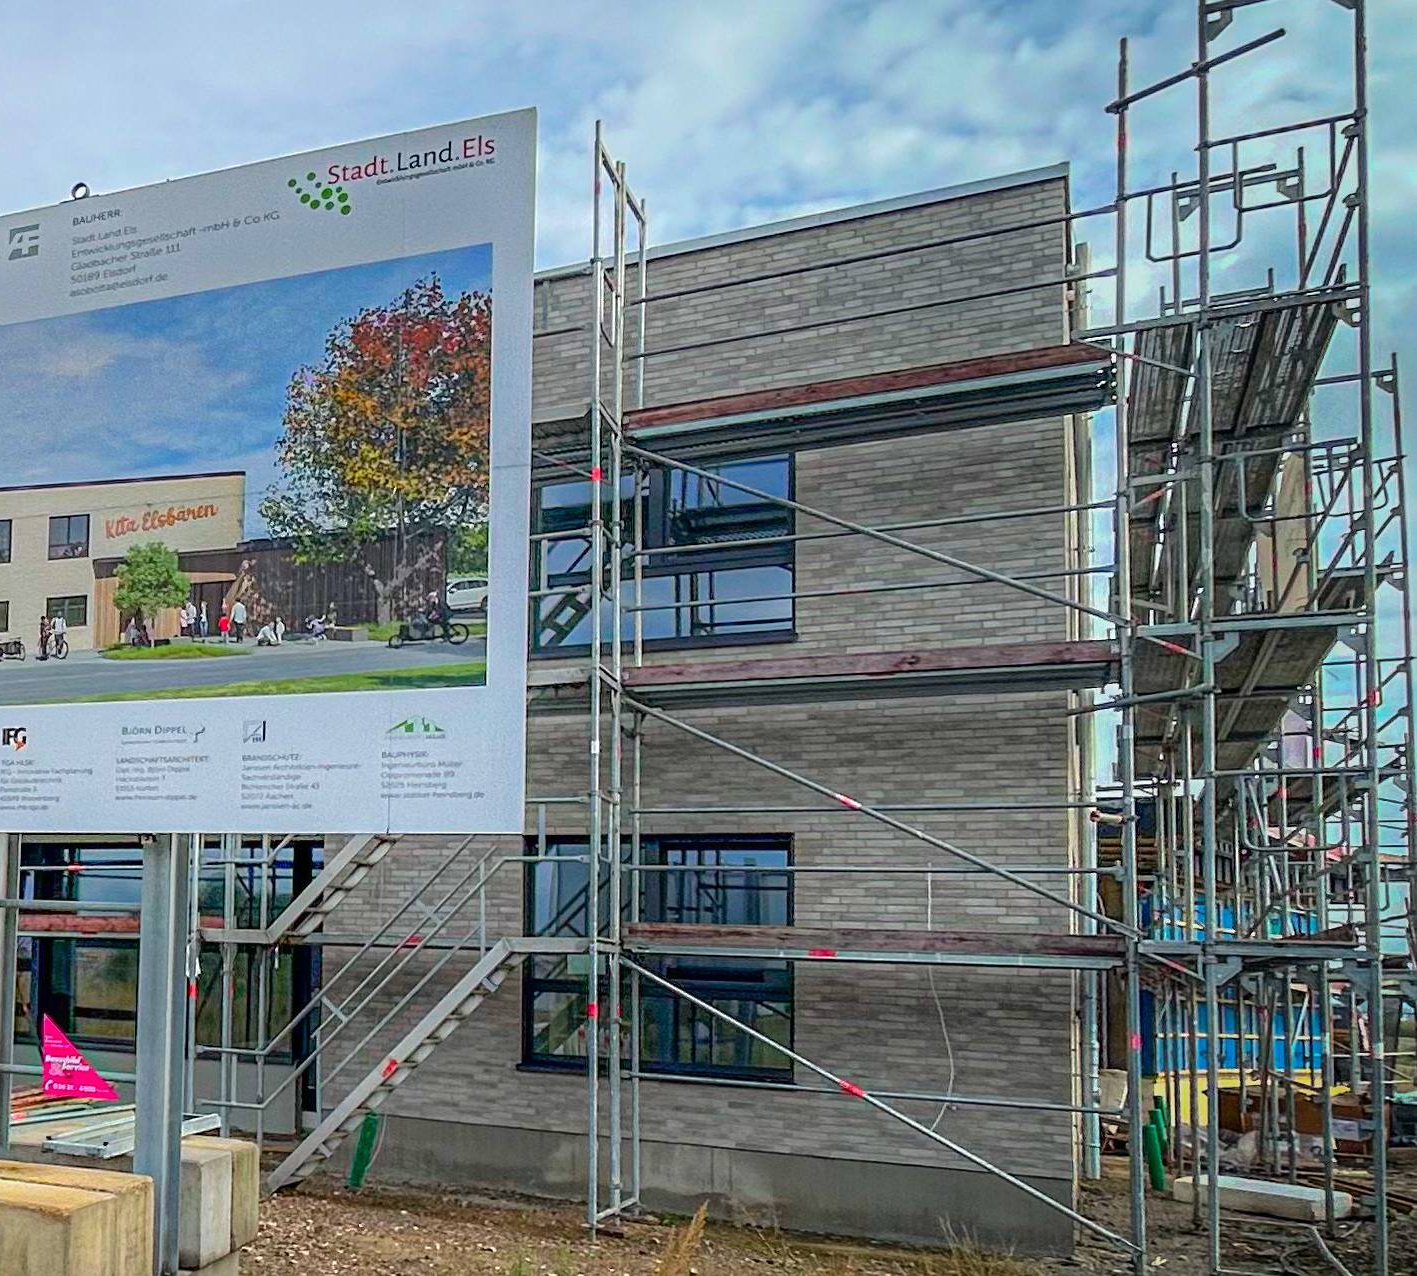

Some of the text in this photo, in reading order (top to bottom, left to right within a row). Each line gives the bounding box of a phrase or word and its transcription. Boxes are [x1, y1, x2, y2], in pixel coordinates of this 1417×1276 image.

[233, 218, 241, 228] &
[130, 247, 162, 260] Straße
[105, 503, 219, 539] Kita Elsbären
[2, 727, 27, 746] IFG
[154, 725, 187, 735] DIPPEL
